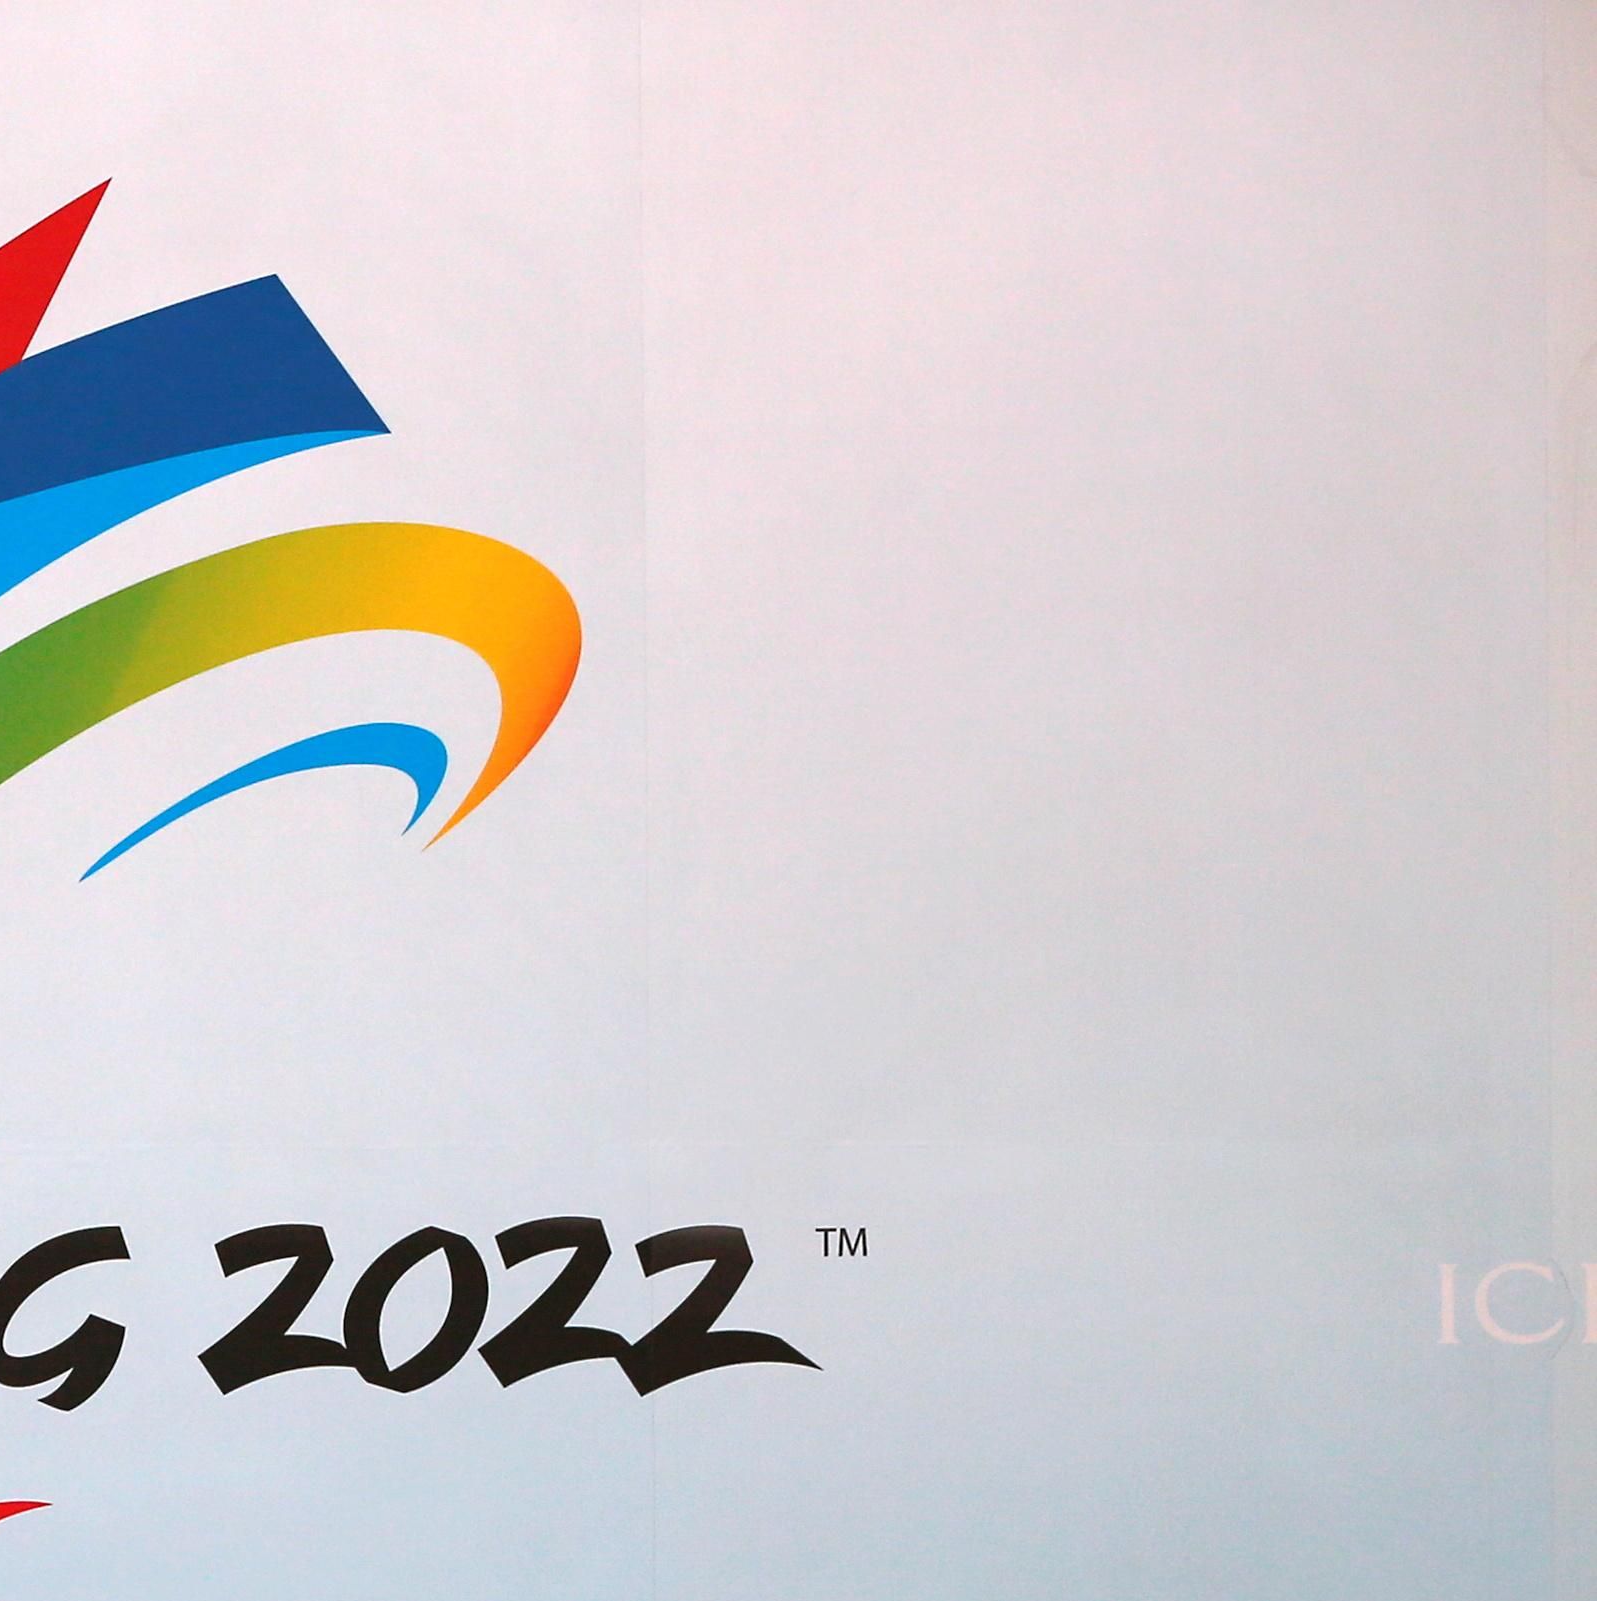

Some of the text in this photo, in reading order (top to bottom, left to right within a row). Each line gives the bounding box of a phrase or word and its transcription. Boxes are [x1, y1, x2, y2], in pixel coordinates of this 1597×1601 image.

[196, 1214, 825, 1398] 2022
[813, 1226, 869, 1259] TM
[1437, 1261, 1597, 1345] IC
